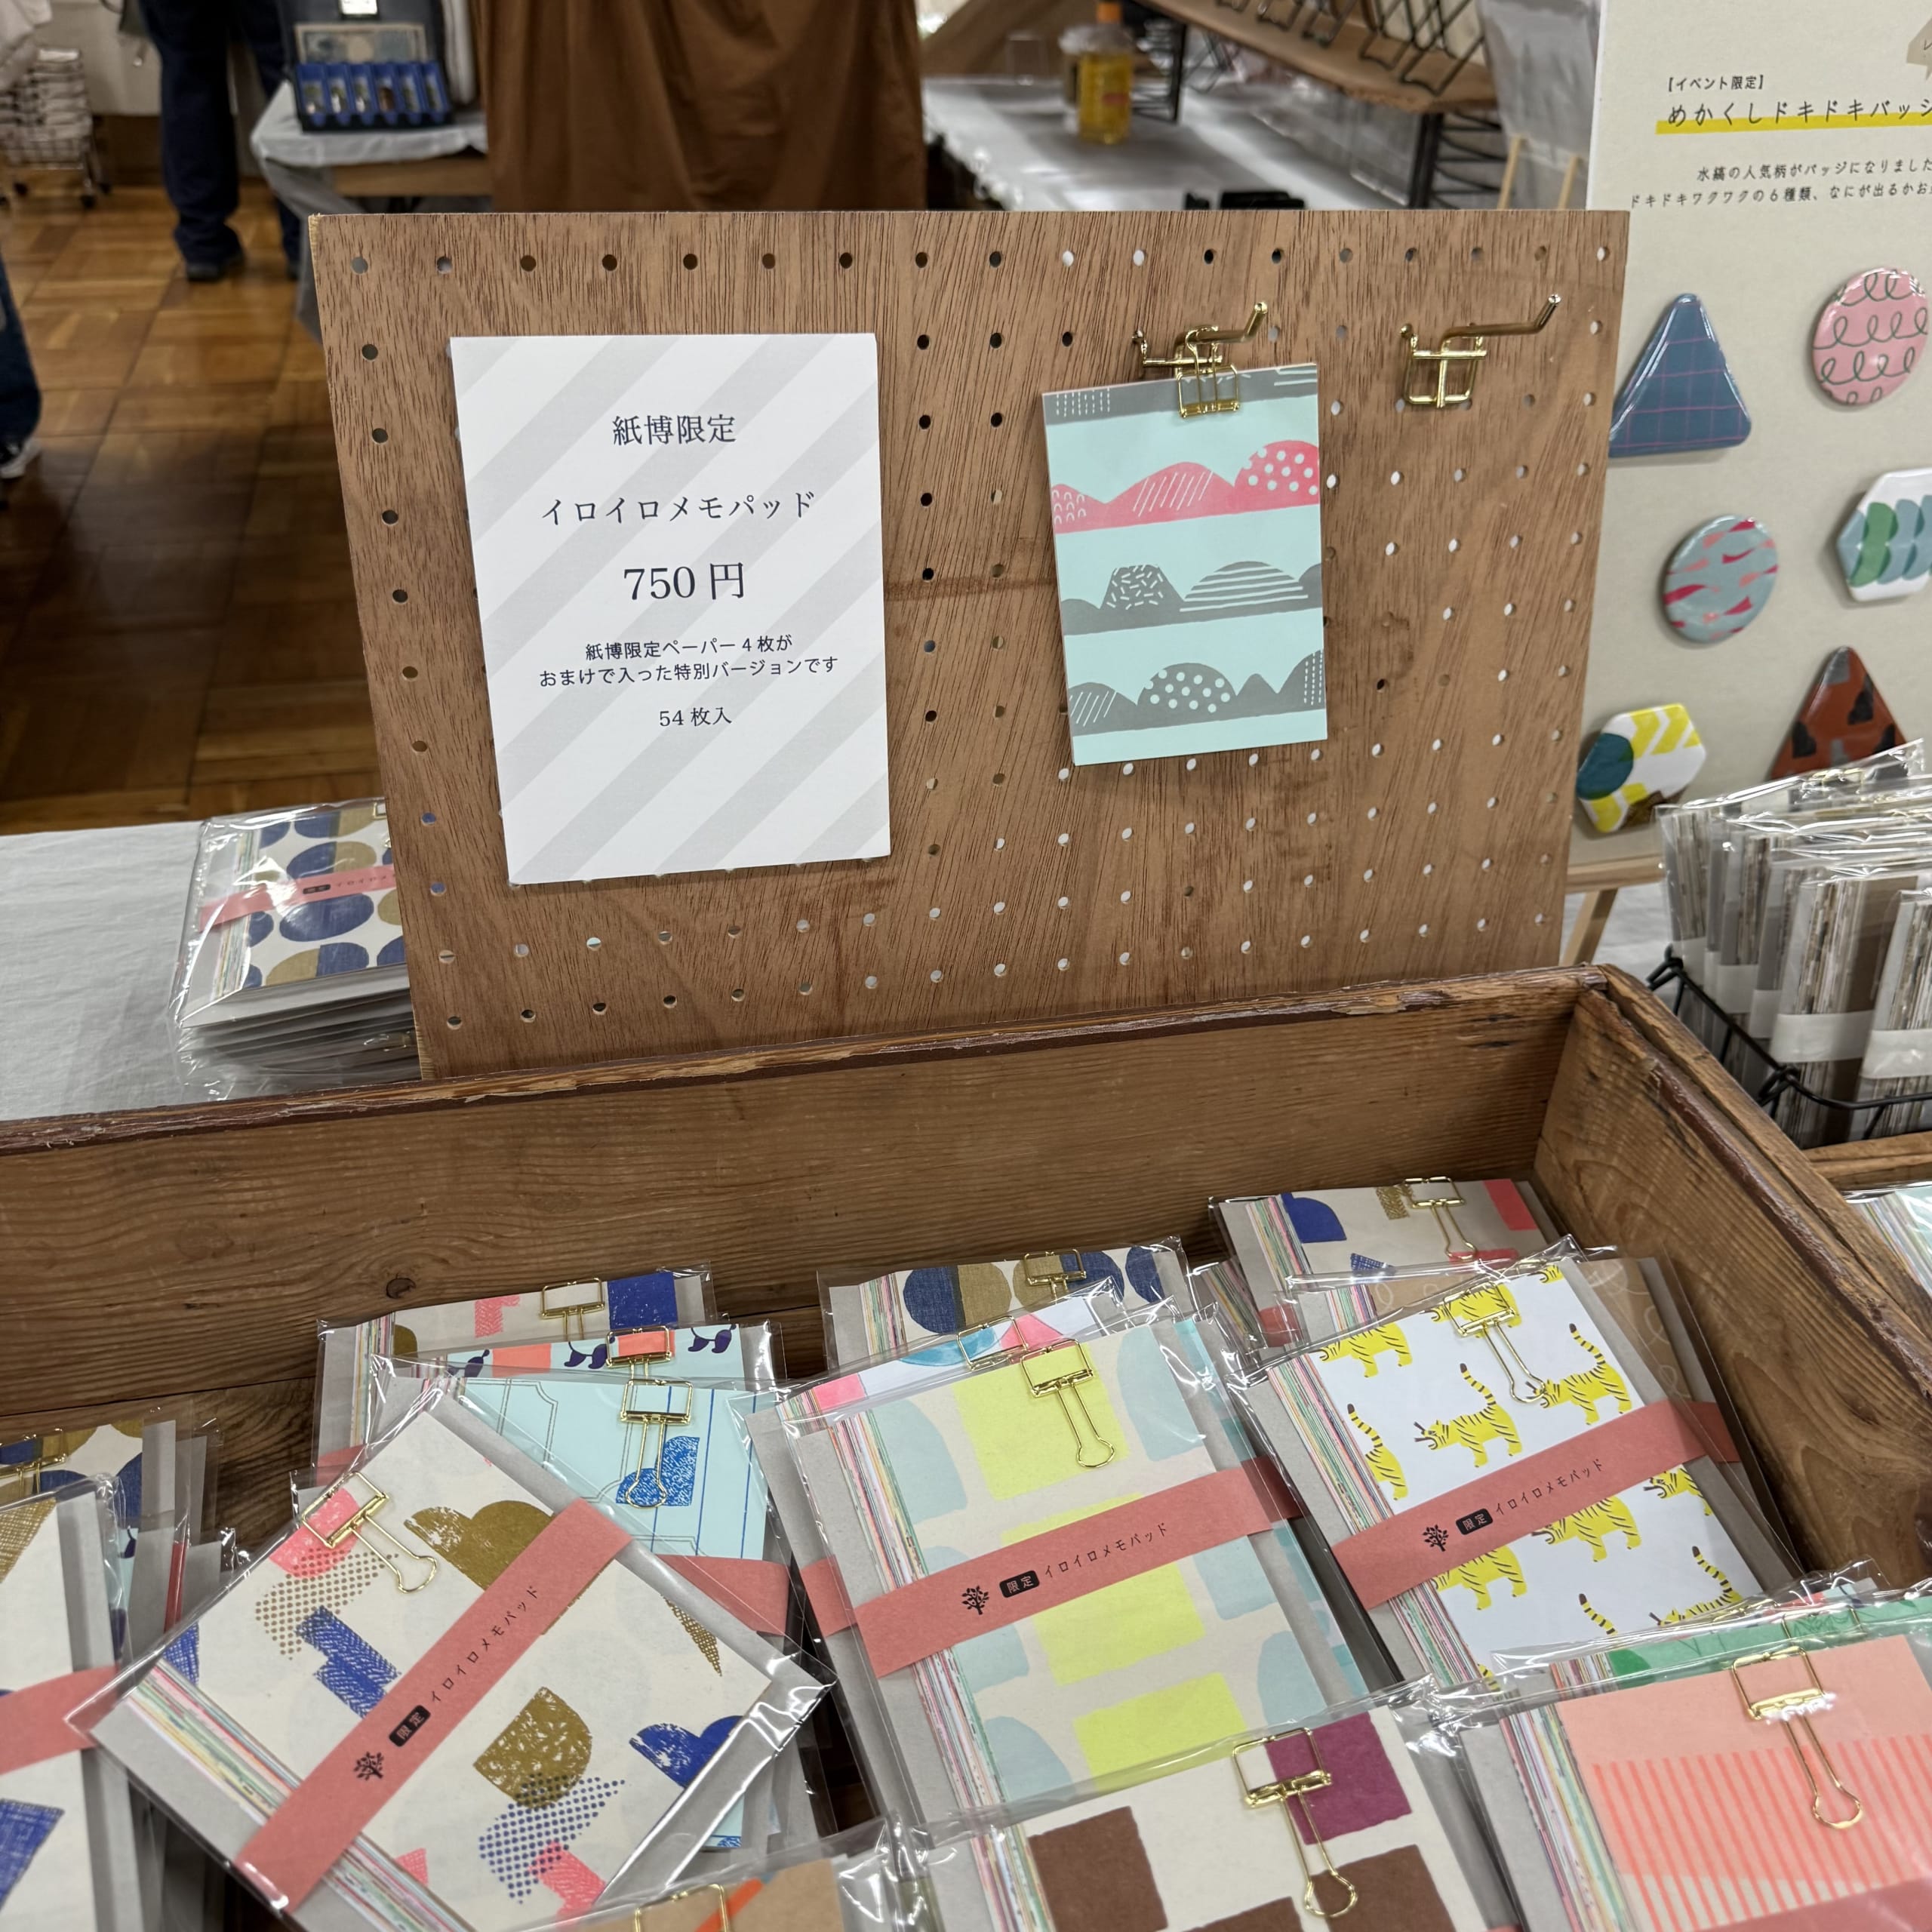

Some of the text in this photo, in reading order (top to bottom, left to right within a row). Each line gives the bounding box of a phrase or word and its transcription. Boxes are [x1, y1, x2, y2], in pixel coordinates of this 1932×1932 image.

[611, 414, 737, 447] 紙博限定
[541, 491, 816, 526] イロイロメモパッド
[538, 656, 839, 688] おまけで入った特別バージョンです
